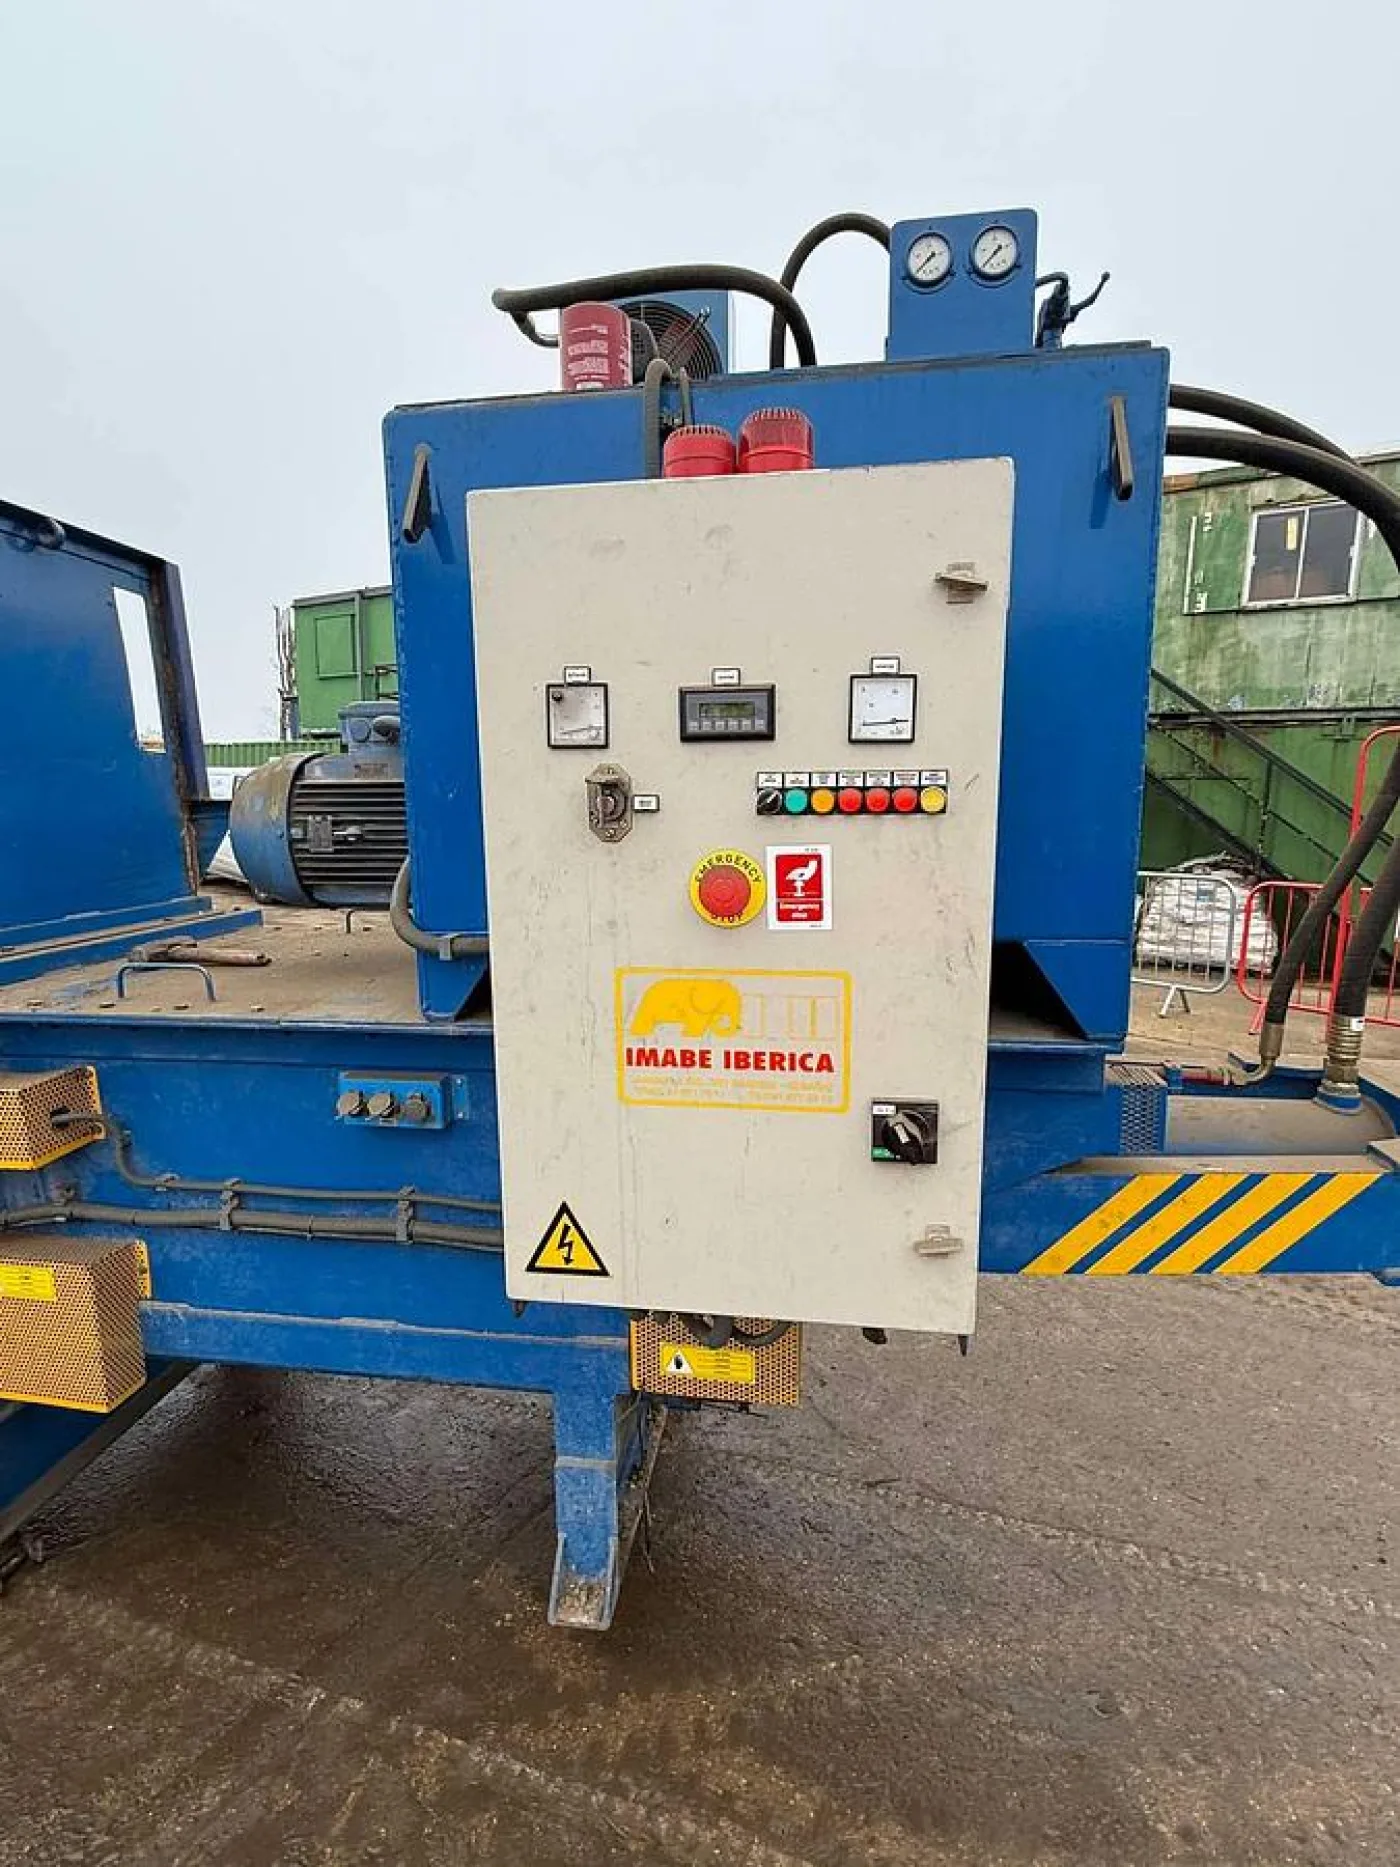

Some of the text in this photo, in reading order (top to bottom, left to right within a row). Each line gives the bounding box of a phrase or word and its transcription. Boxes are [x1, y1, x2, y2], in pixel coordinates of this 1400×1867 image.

[695, 854, 762, 882] EMERGENCY
[625, 1047, 835, 1073] IMABE IBERICA
